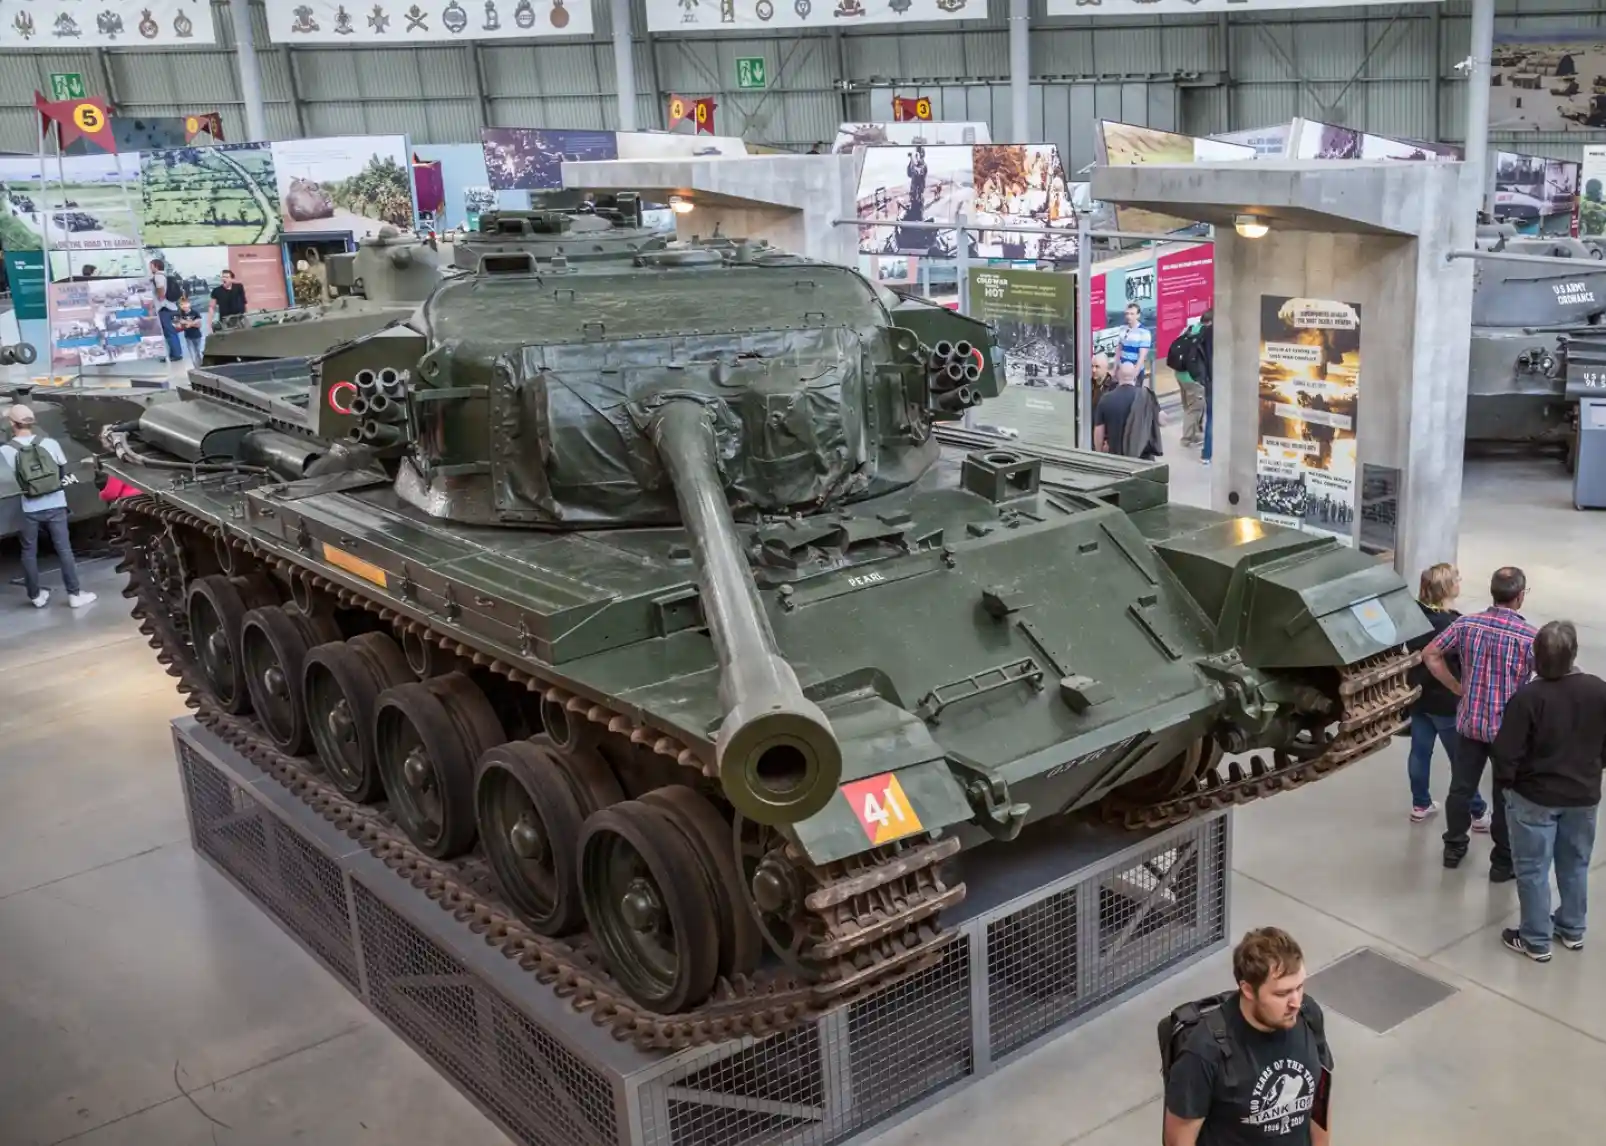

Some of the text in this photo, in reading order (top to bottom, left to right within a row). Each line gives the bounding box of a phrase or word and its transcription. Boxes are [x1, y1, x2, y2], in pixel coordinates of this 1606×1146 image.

[82, 109, 98, 127] 5
[919, 103, 928, 115] 3
[984, 287, 1005, 298] HOT
[848, 572, 886, 587] PEARL
[864, 788, 906, 826] 41
[1252, 1066, 1273, 1096] YEARS
[1273, 1059, 1285, 1070] OF
[1286, 1059, 1304, 1073] THE
[1255, 1103, 1289, 1122] TANK
